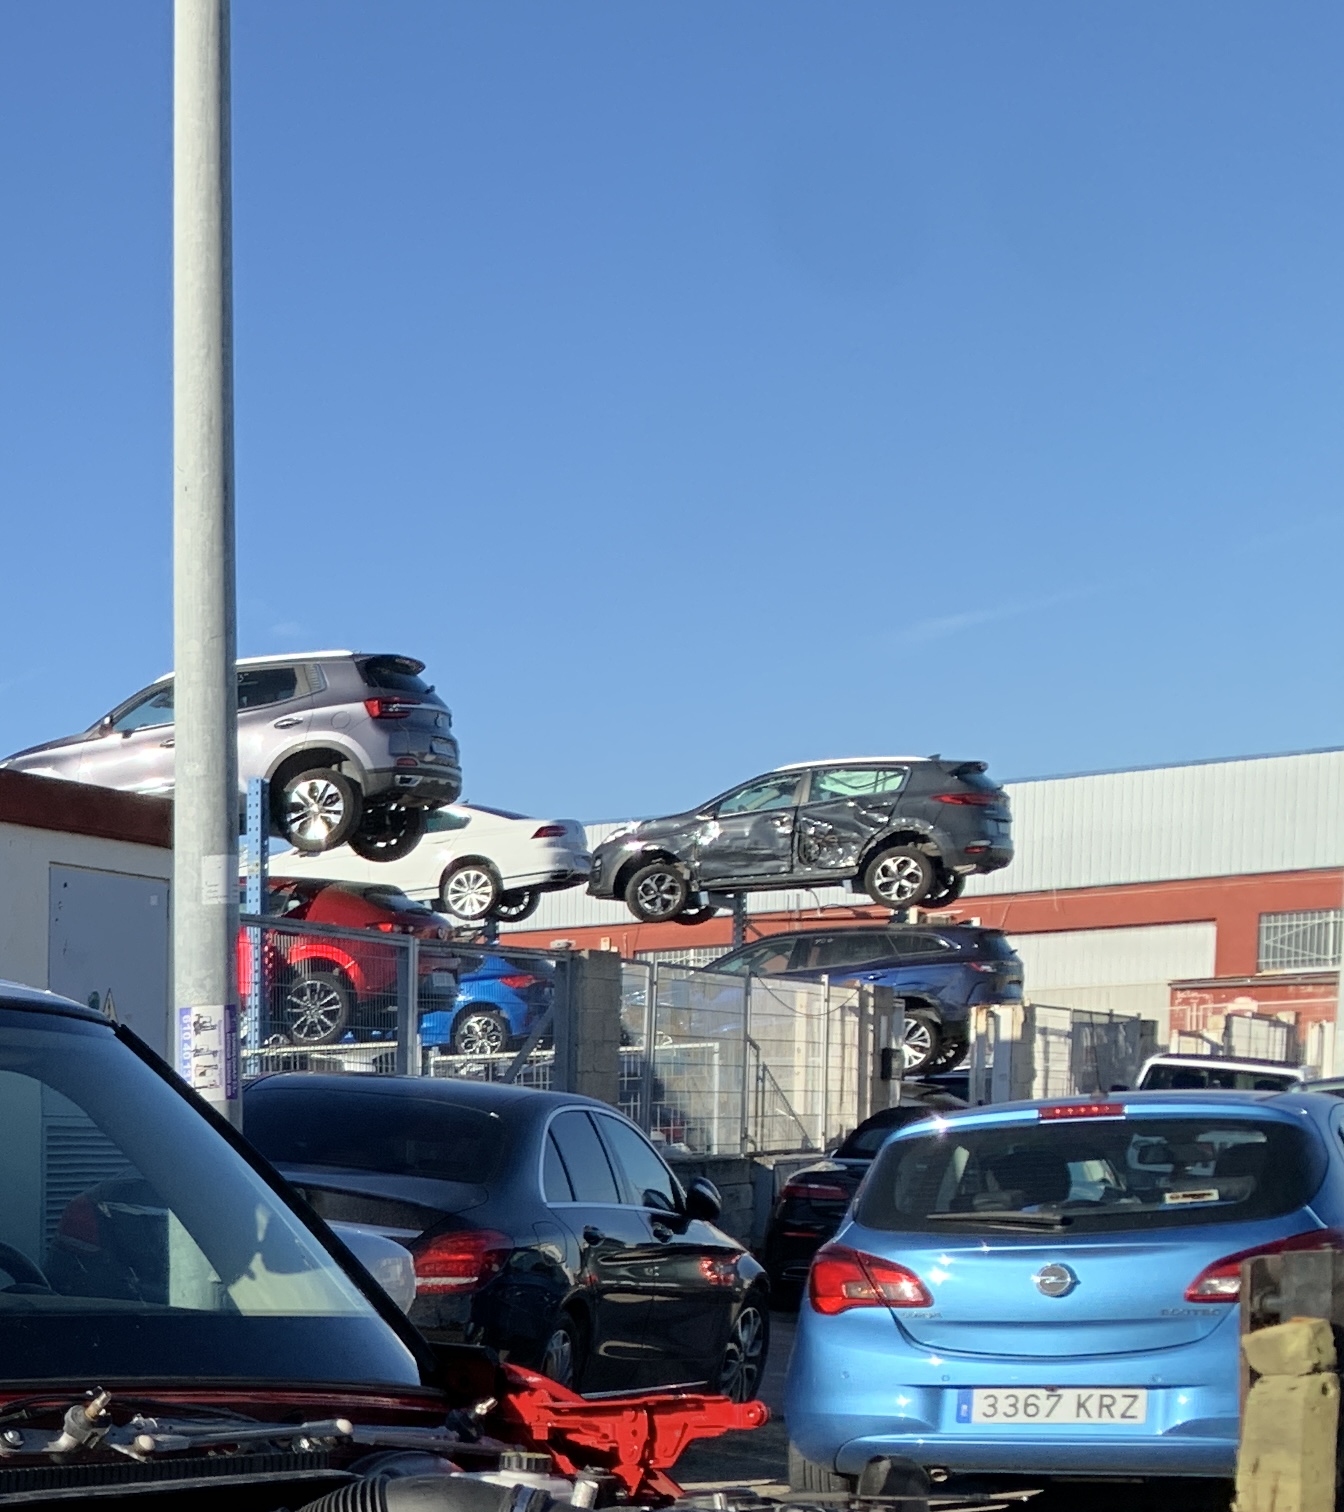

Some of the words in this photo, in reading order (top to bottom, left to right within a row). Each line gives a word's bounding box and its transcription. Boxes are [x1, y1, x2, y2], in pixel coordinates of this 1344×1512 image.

[182, 1015, 191, 1040] 610
[182, 1044, 191, 1060] 40
[982, 1394, 1064, 1419] 3367
[1076, 1394, 1140, 1419] KRZ
